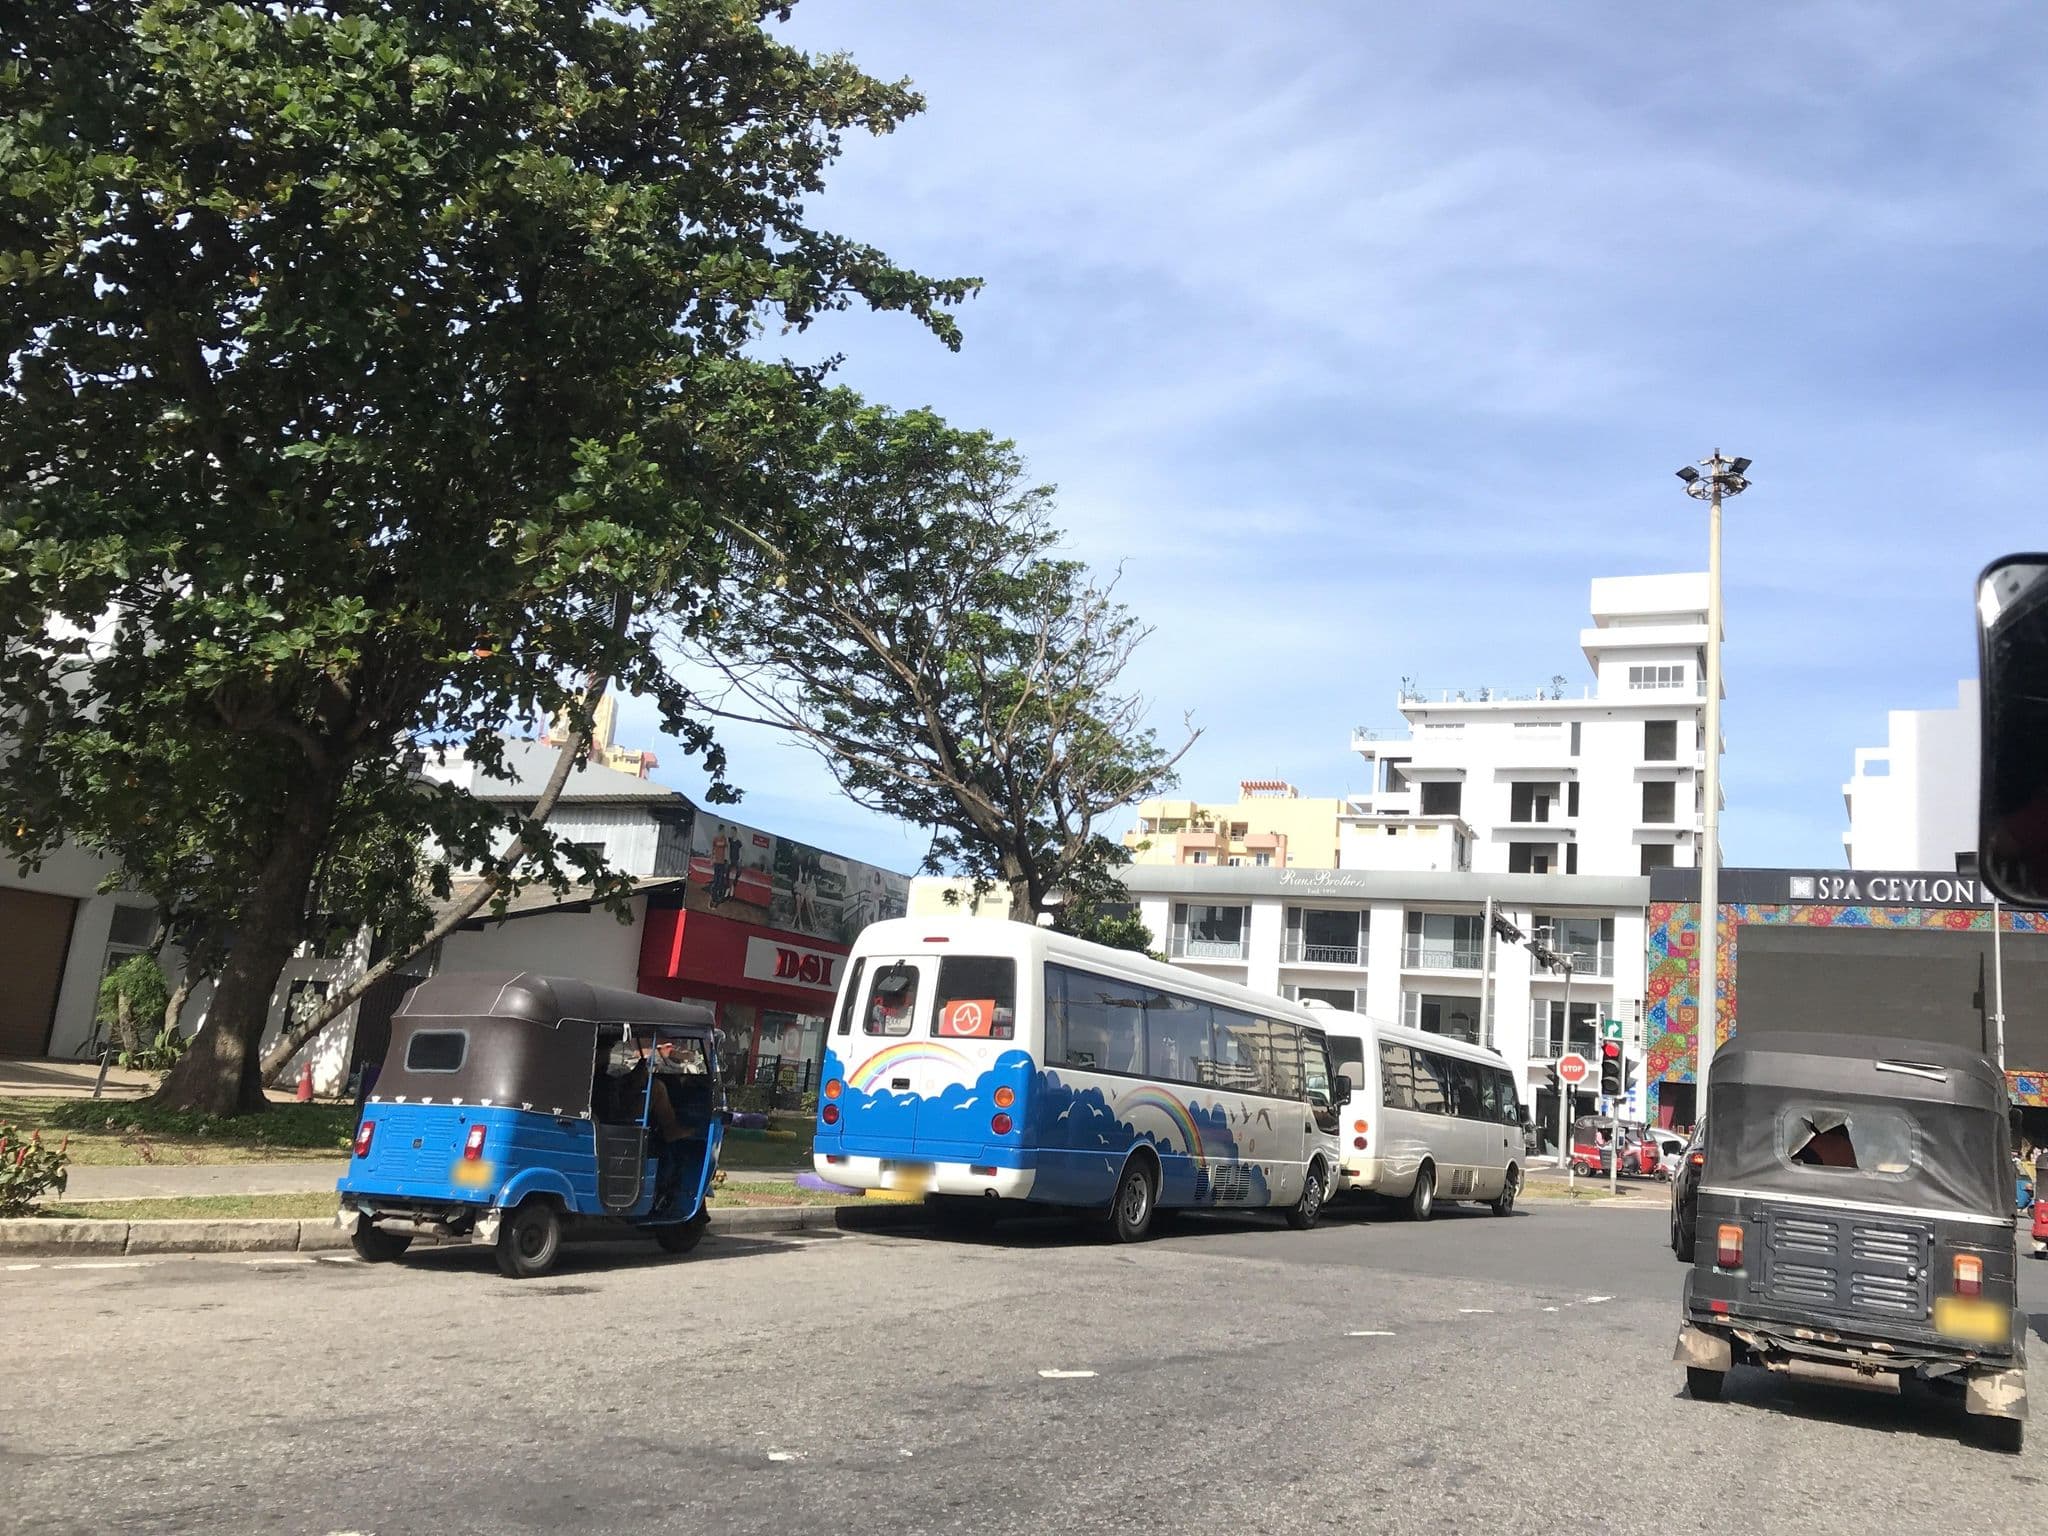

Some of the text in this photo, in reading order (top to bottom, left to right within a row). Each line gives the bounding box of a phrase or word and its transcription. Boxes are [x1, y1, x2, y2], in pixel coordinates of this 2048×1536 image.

[1314, 871, 1366, 887] Brothers
[1819, 876, 1975, 903] SPA CEYLON
[773, 947, 834, 986] DSI
[1562, 1065, 1583, 1073] STOP
